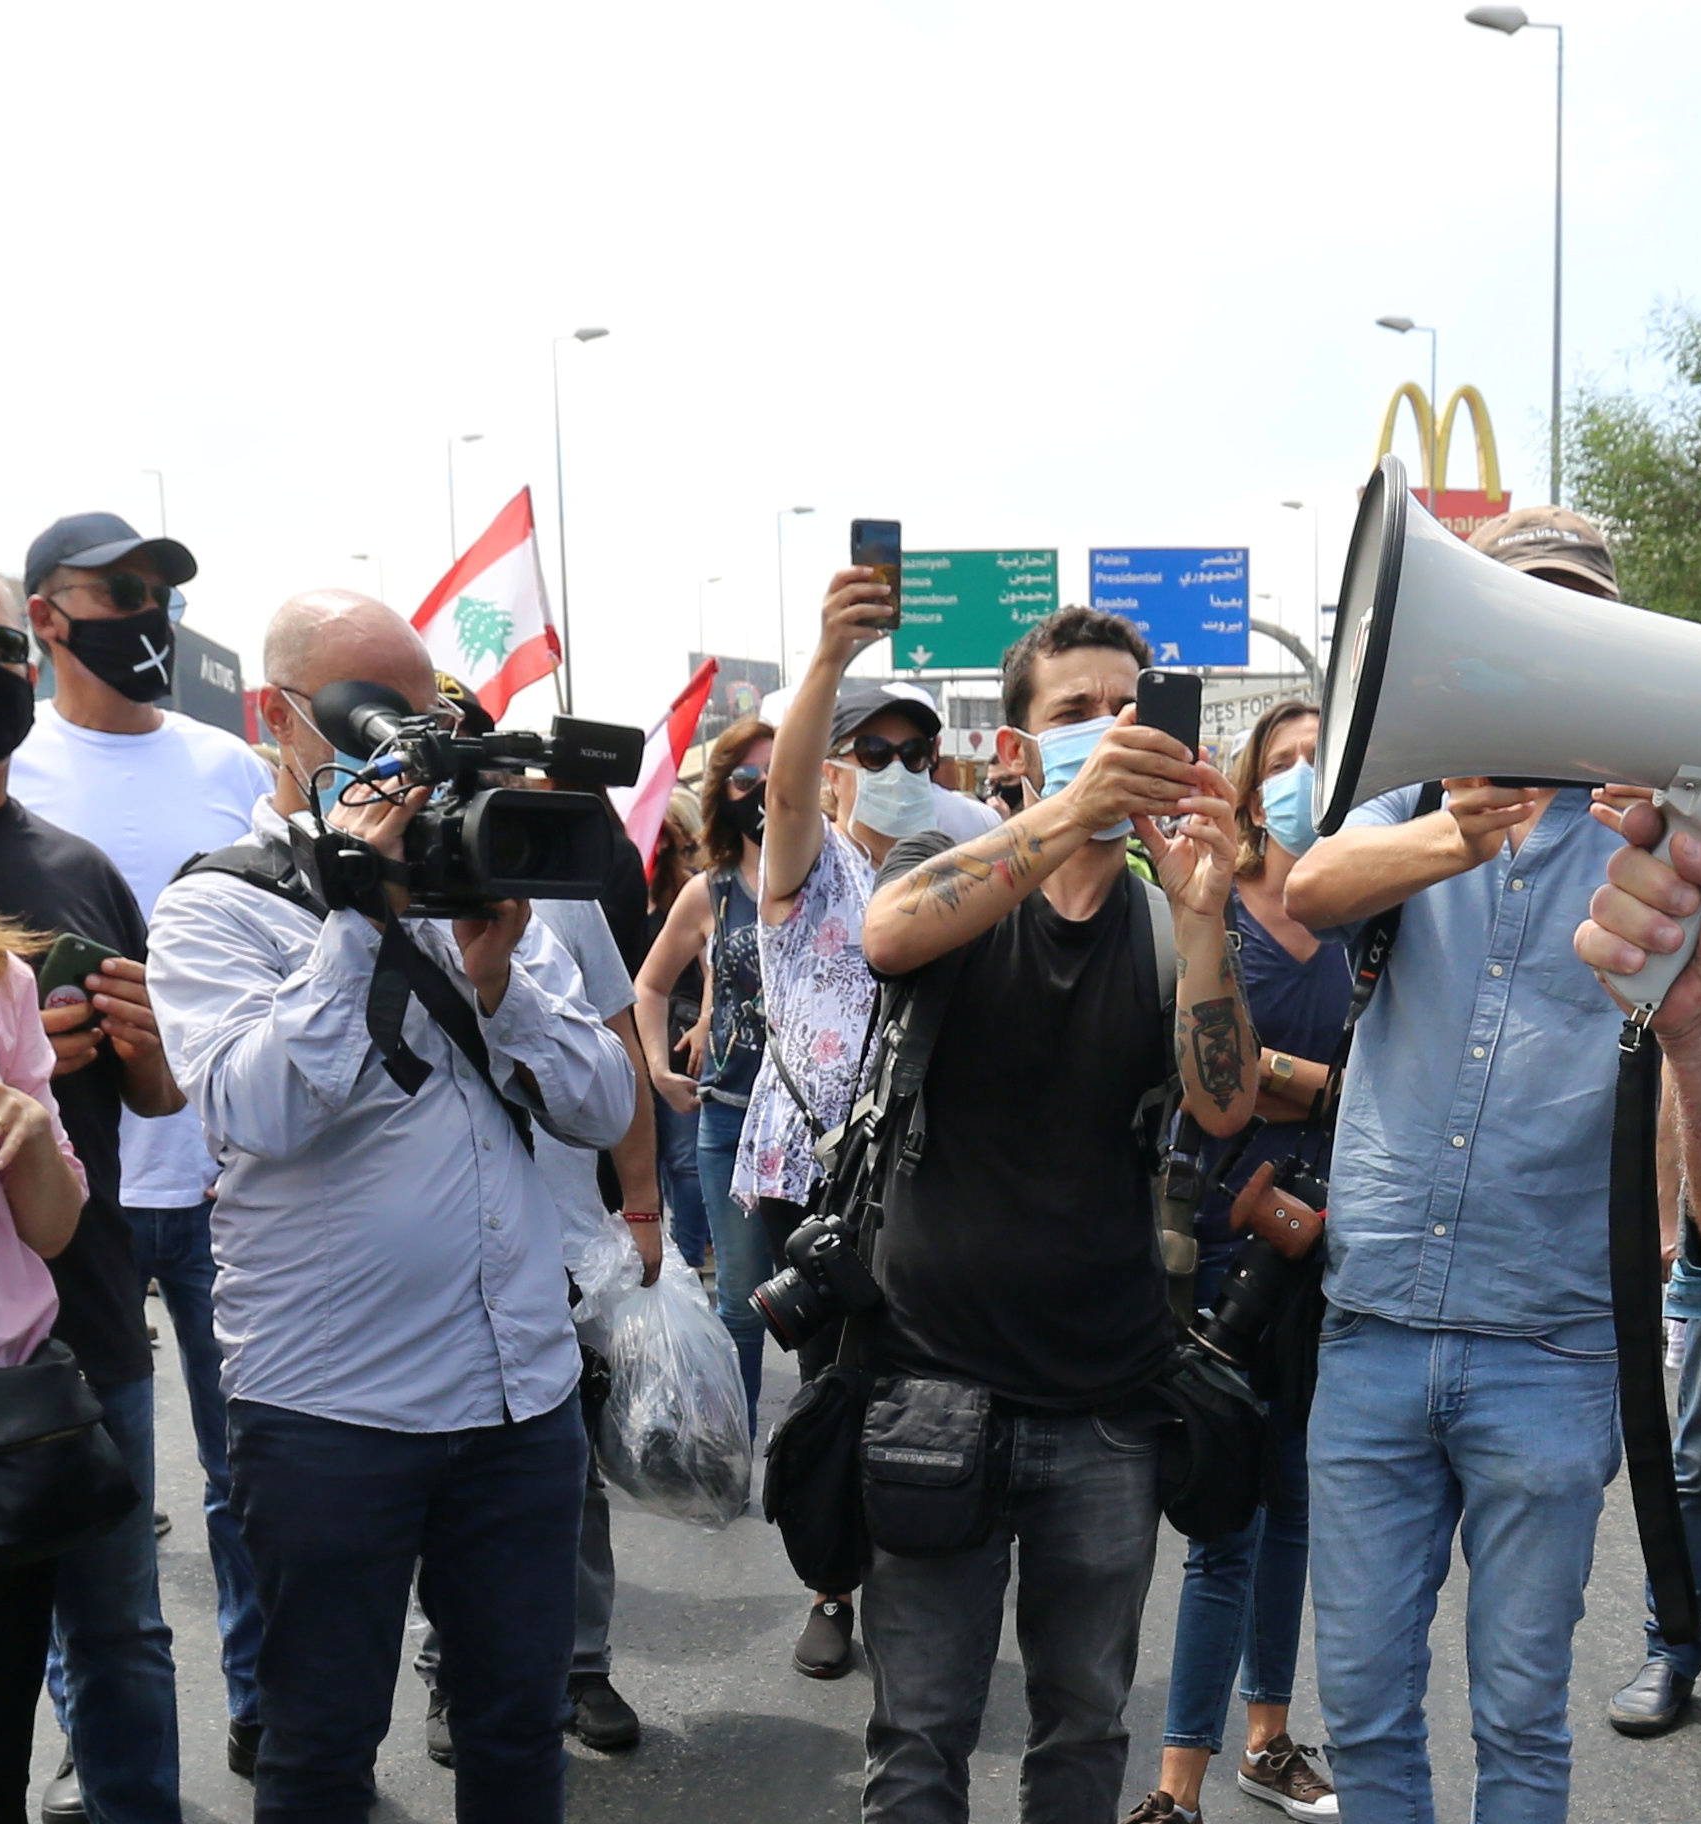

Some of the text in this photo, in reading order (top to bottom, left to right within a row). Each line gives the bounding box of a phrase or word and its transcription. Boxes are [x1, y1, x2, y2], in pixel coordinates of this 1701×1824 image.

[1536, 528, 1560, 538] USA
[900, 557, 951, 571] azmiyeh
[997, 553, 1052, 569] الحازمية
[1095, 553, 1131, 566] Palais
[1200, 551, 1243, 568] القصر
[1179, 567, 1243, 587] الجمهوري
[999, 589, 1052, 604] بحمدون
[1095, 596, 1139, 609] Baabda
[1201, 621, 1243, 633] بيروت
